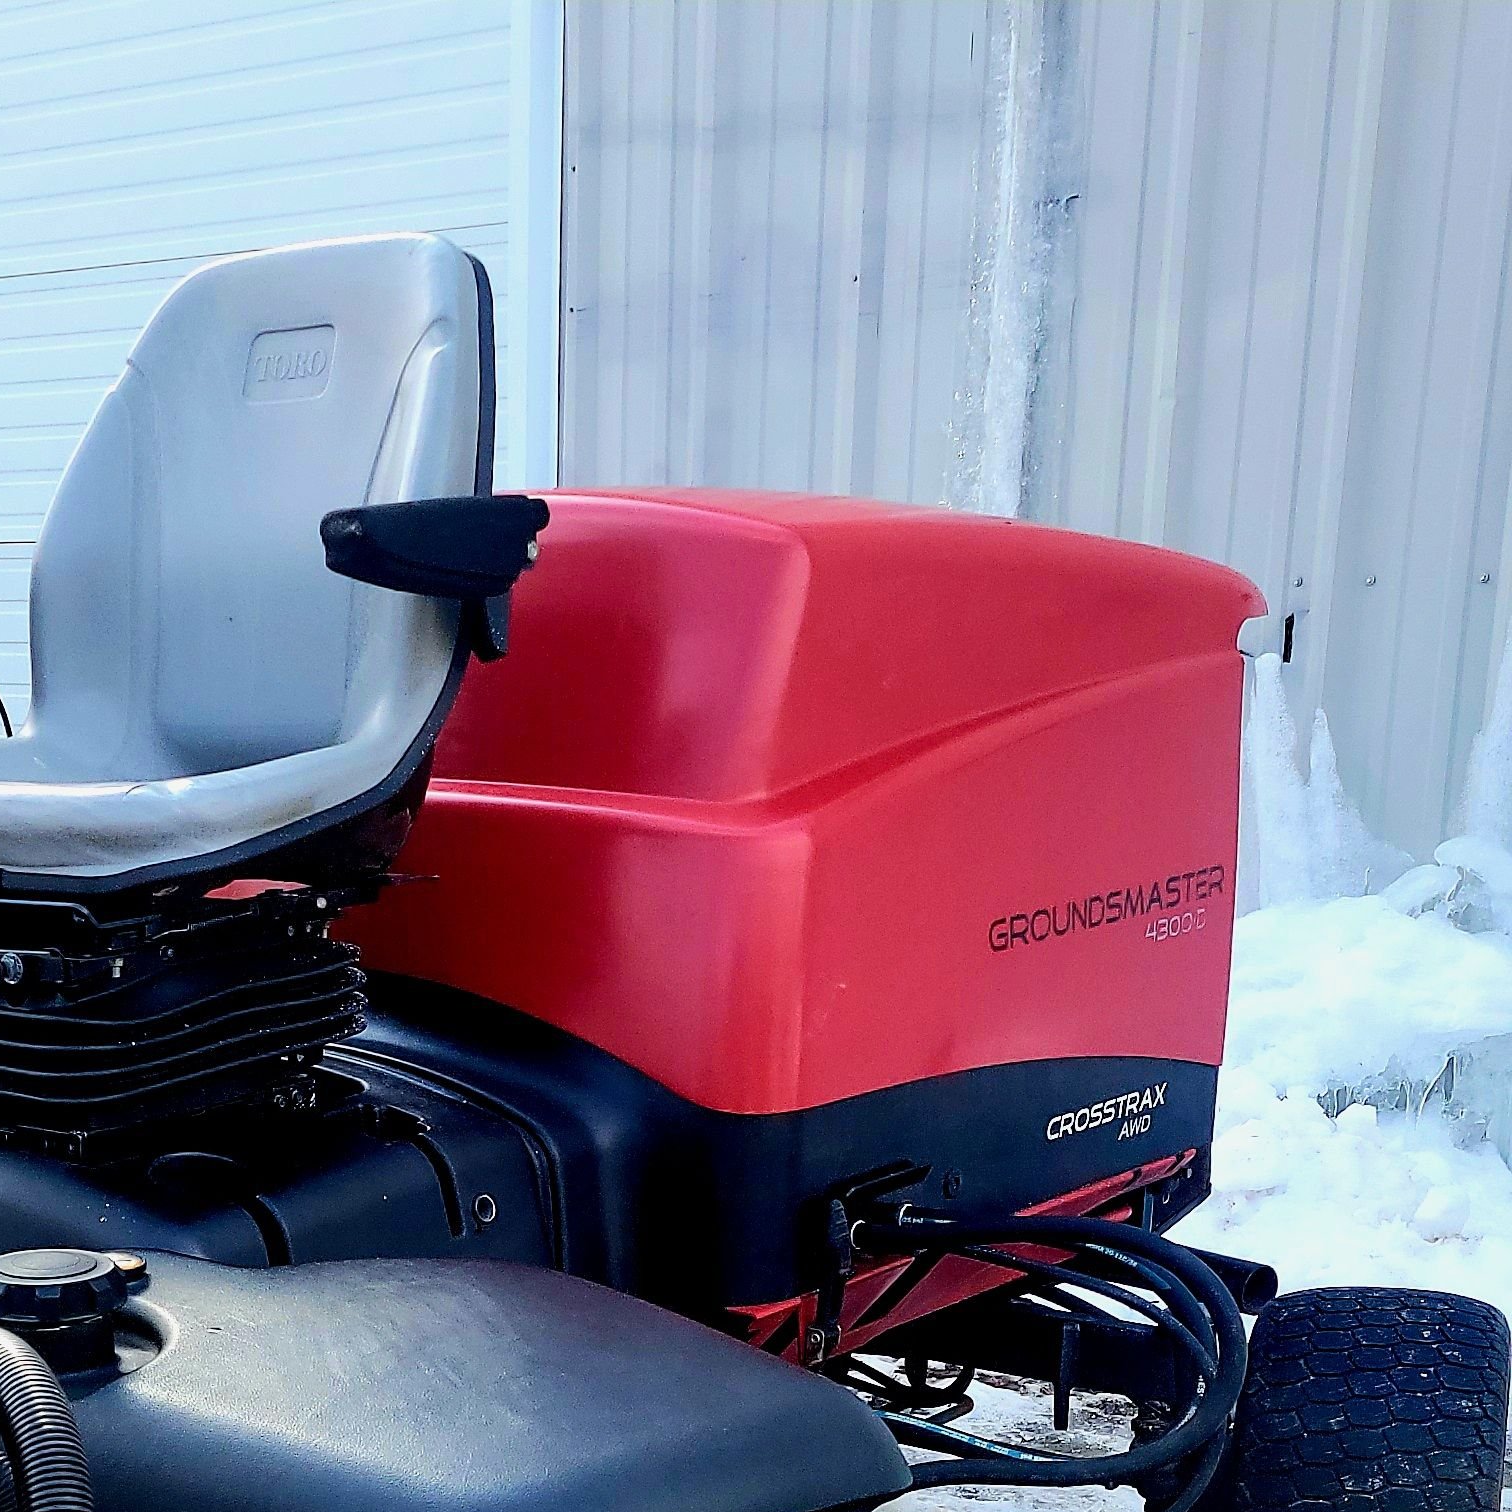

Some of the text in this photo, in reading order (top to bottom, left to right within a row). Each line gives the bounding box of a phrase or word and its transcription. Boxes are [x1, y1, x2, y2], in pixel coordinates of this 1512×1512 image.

[253, 350, 328, 382] TORO
[988, 865, 1226, 952] GROUNDSMASTER
[1046, 1082, 1168, 1141] CROSSTRAX
[1117, 1114, 1152, 1141] AWD
